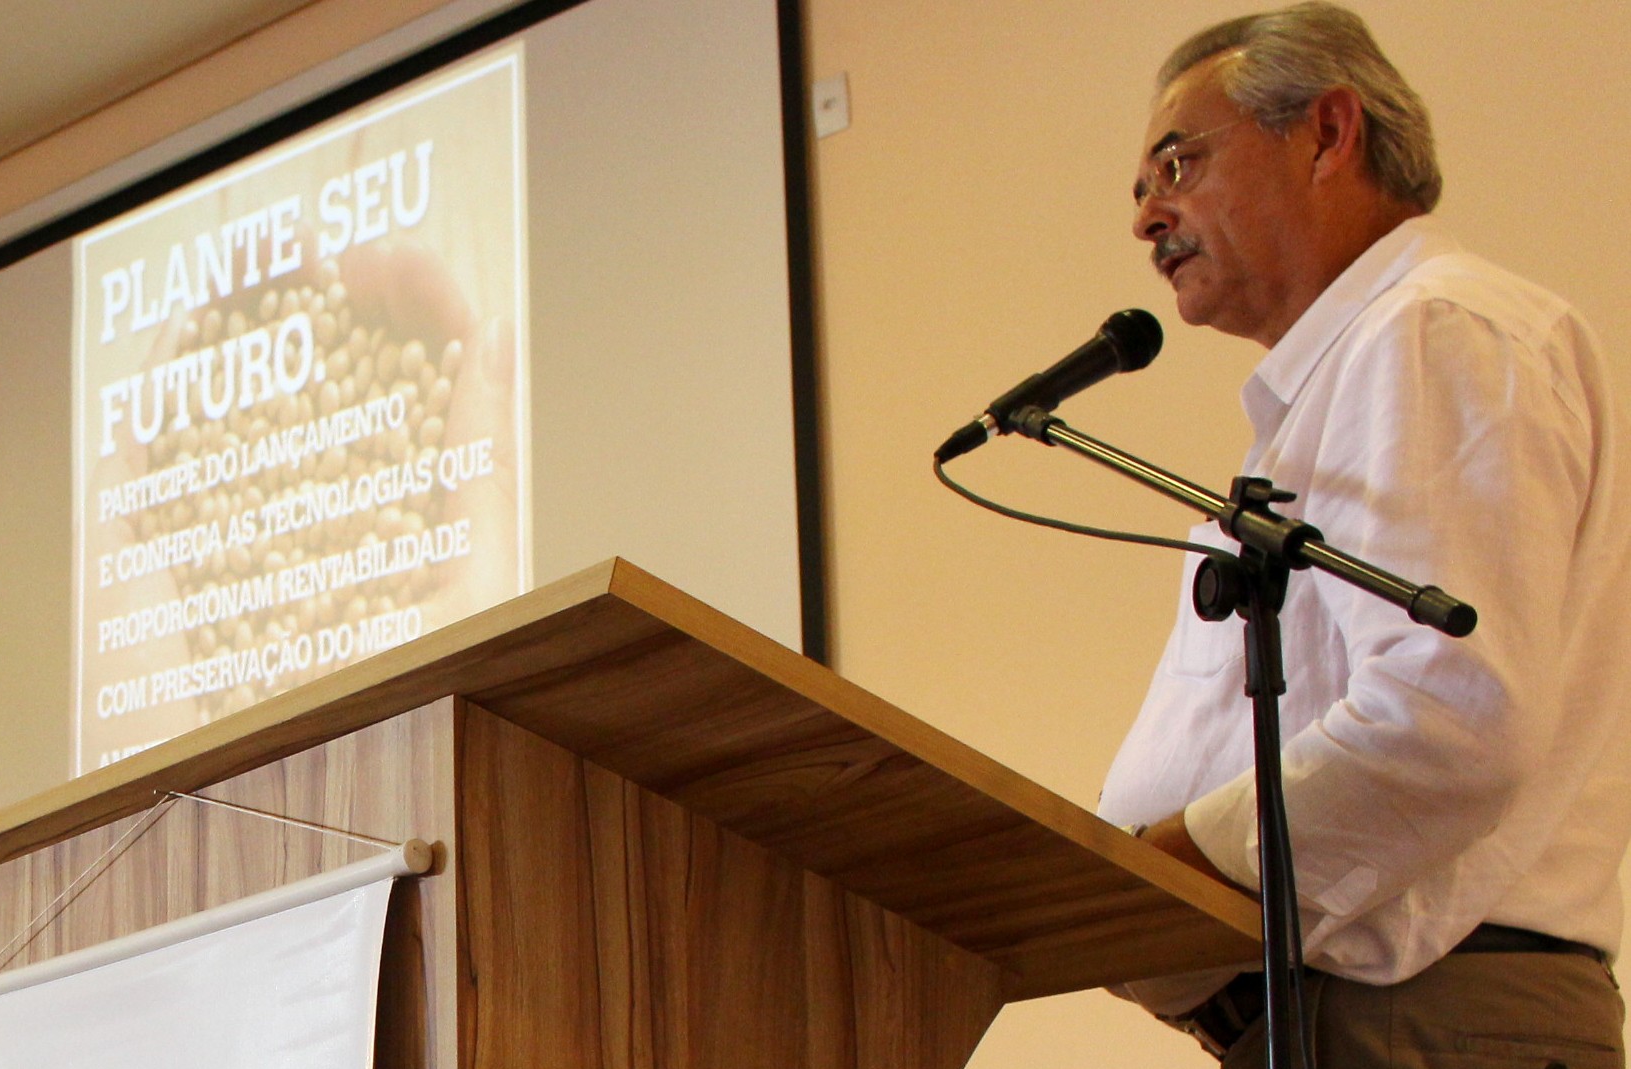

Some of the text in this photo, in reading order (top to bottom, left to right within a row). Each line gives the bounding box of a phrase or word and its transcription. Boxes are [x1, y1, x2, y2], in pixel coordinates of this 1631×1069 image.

[100, 140, 433, 344] PLANTE SEU
[99, 312, 327, 456] FUTURO.
[99, 391, 406, 523] PARTICIPE DO LANÇAMENTO
[99, 437, 494, 588] E CONHEÇA AS TECNOLOGIAS QUE
[98, 518, 471, 654] PROPORCIONAM RENTABILIDADE
[97, 606, 422, 720] COM PRESERVAÇÃO DO MEIO
